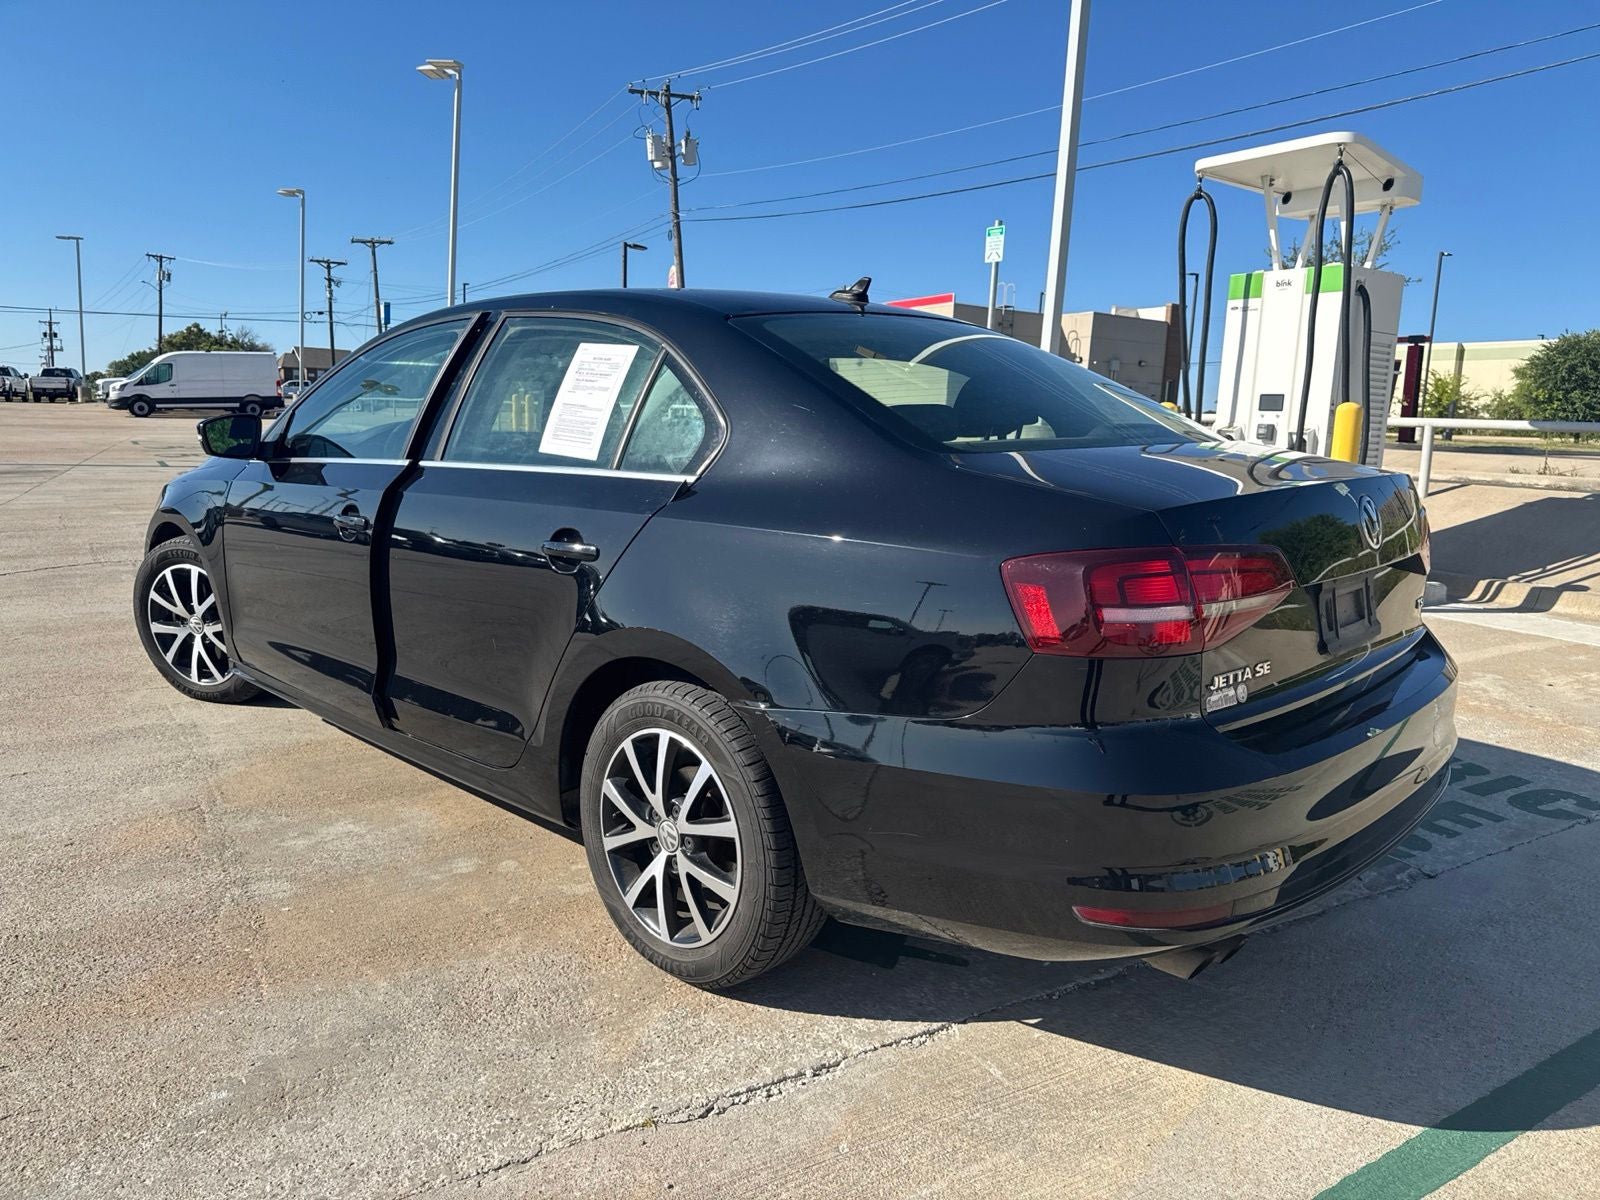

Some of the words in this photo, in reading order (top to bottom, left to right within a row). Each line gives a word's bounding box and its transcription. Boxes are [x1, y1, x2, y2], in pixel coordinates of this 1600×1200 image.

[1275, 279, 1292, 288] blink
[1210, 668, 1252, 690] JETTA
[1254, 661, 1271, 677] SE
